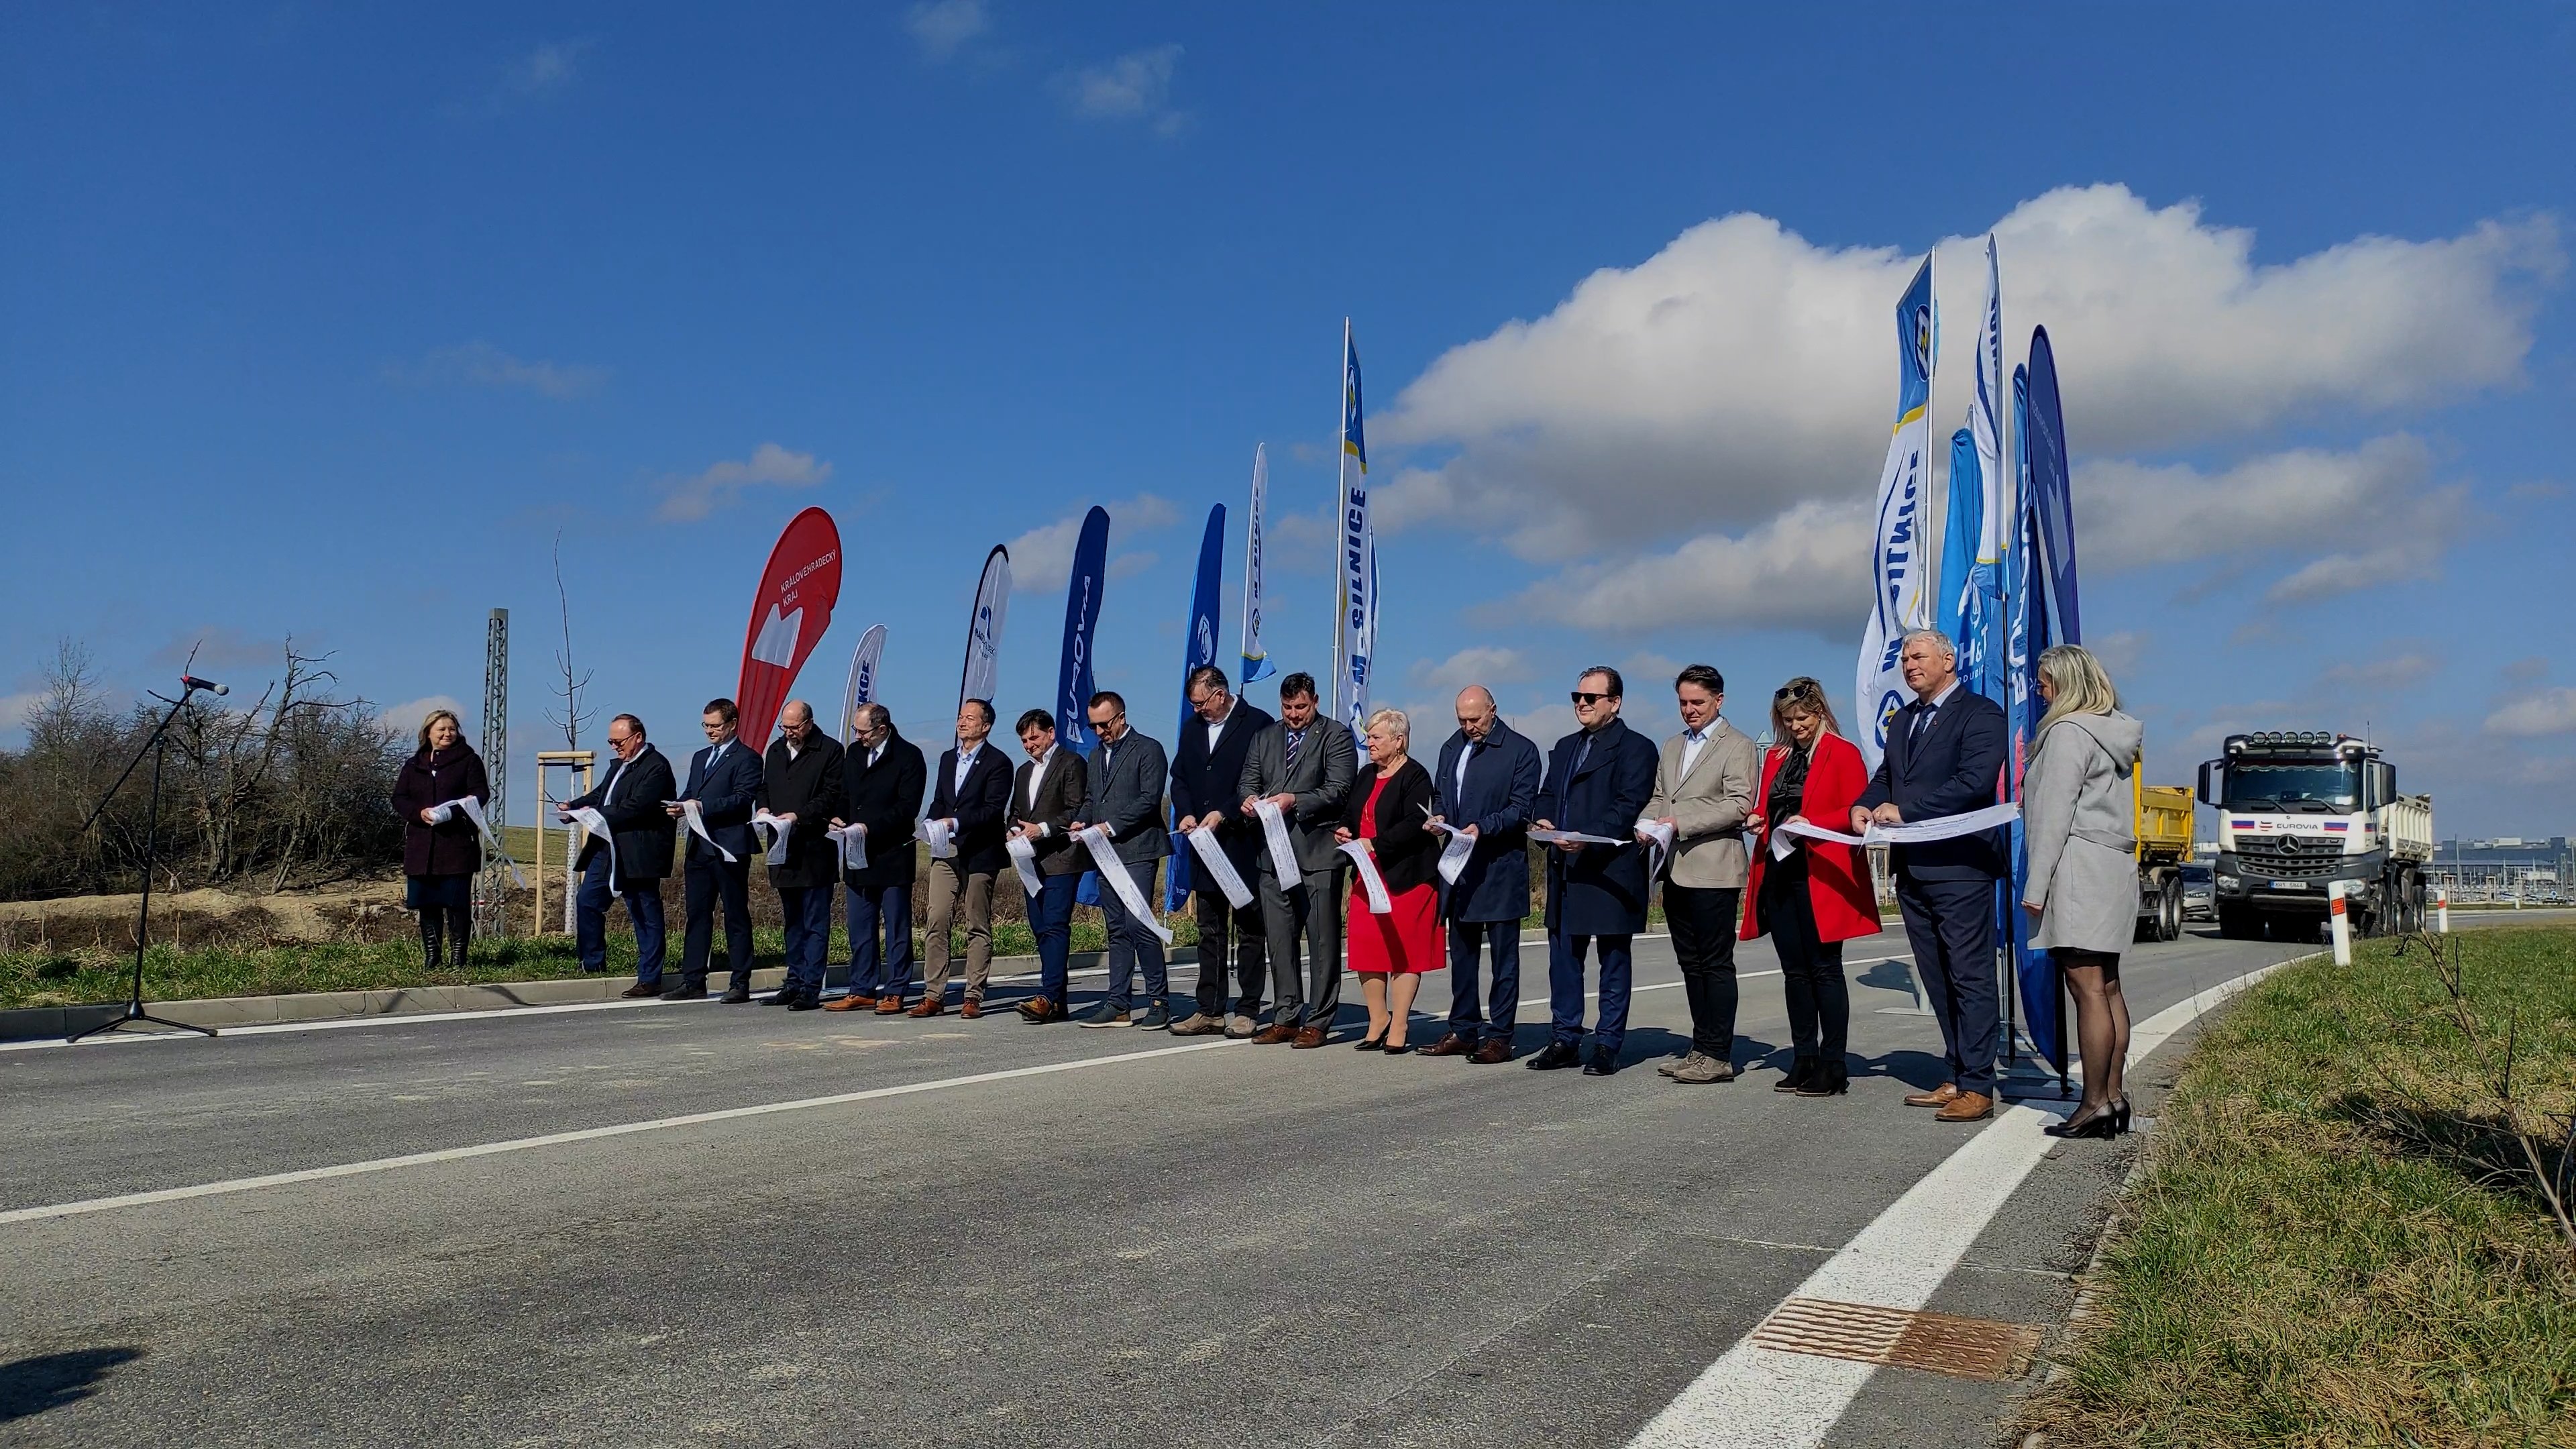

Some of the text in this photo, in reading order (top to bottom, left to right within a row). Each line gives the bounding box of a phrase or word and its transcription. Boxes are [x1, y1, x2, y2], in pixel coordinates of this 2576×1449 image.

[780, 549, 836, 594] KRÁLOVÉHRADECKÝ
[1348, 487, 1366, 630] SILNICE
[782, 588, 798, 607] KRAJ
[1352, 654, 1366, 686] M
[1954, 623, 1988, 672] H&T
[857, 660, 871, 708] KCE
